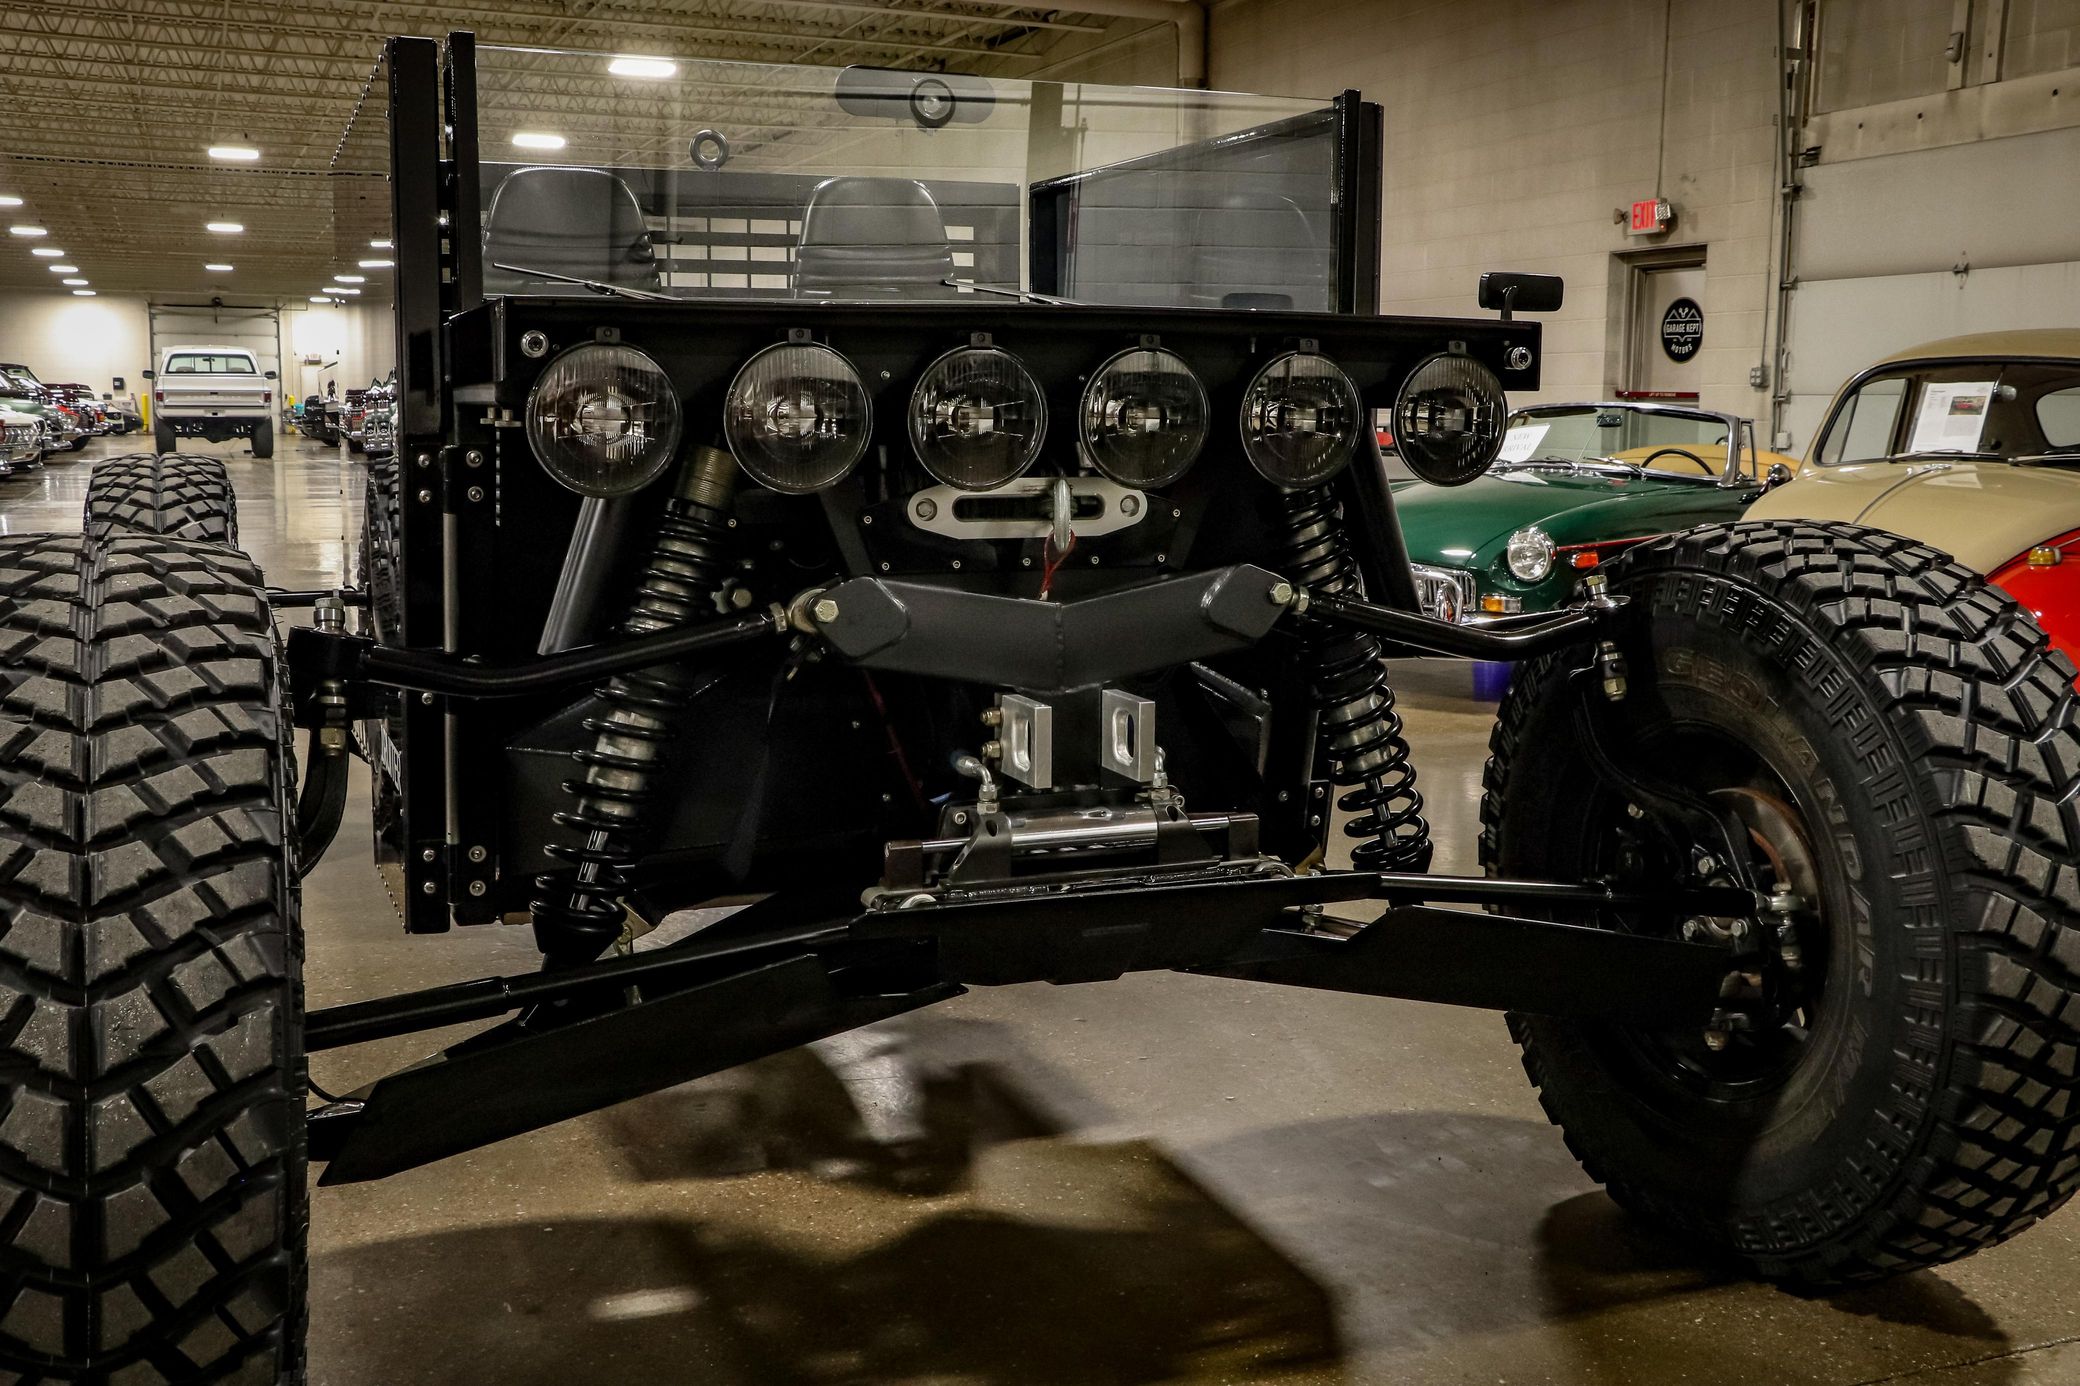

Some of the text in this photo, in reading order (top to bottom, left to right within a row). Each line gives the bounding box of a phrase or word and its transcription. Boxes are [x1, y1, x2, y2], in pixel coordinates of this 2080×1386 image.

[1632, 198, 1656, 230] EXIT
[1666, 322, 1700, 333] GARAGE KEPT
[1670, 343, 1693, 354] MOTORS
